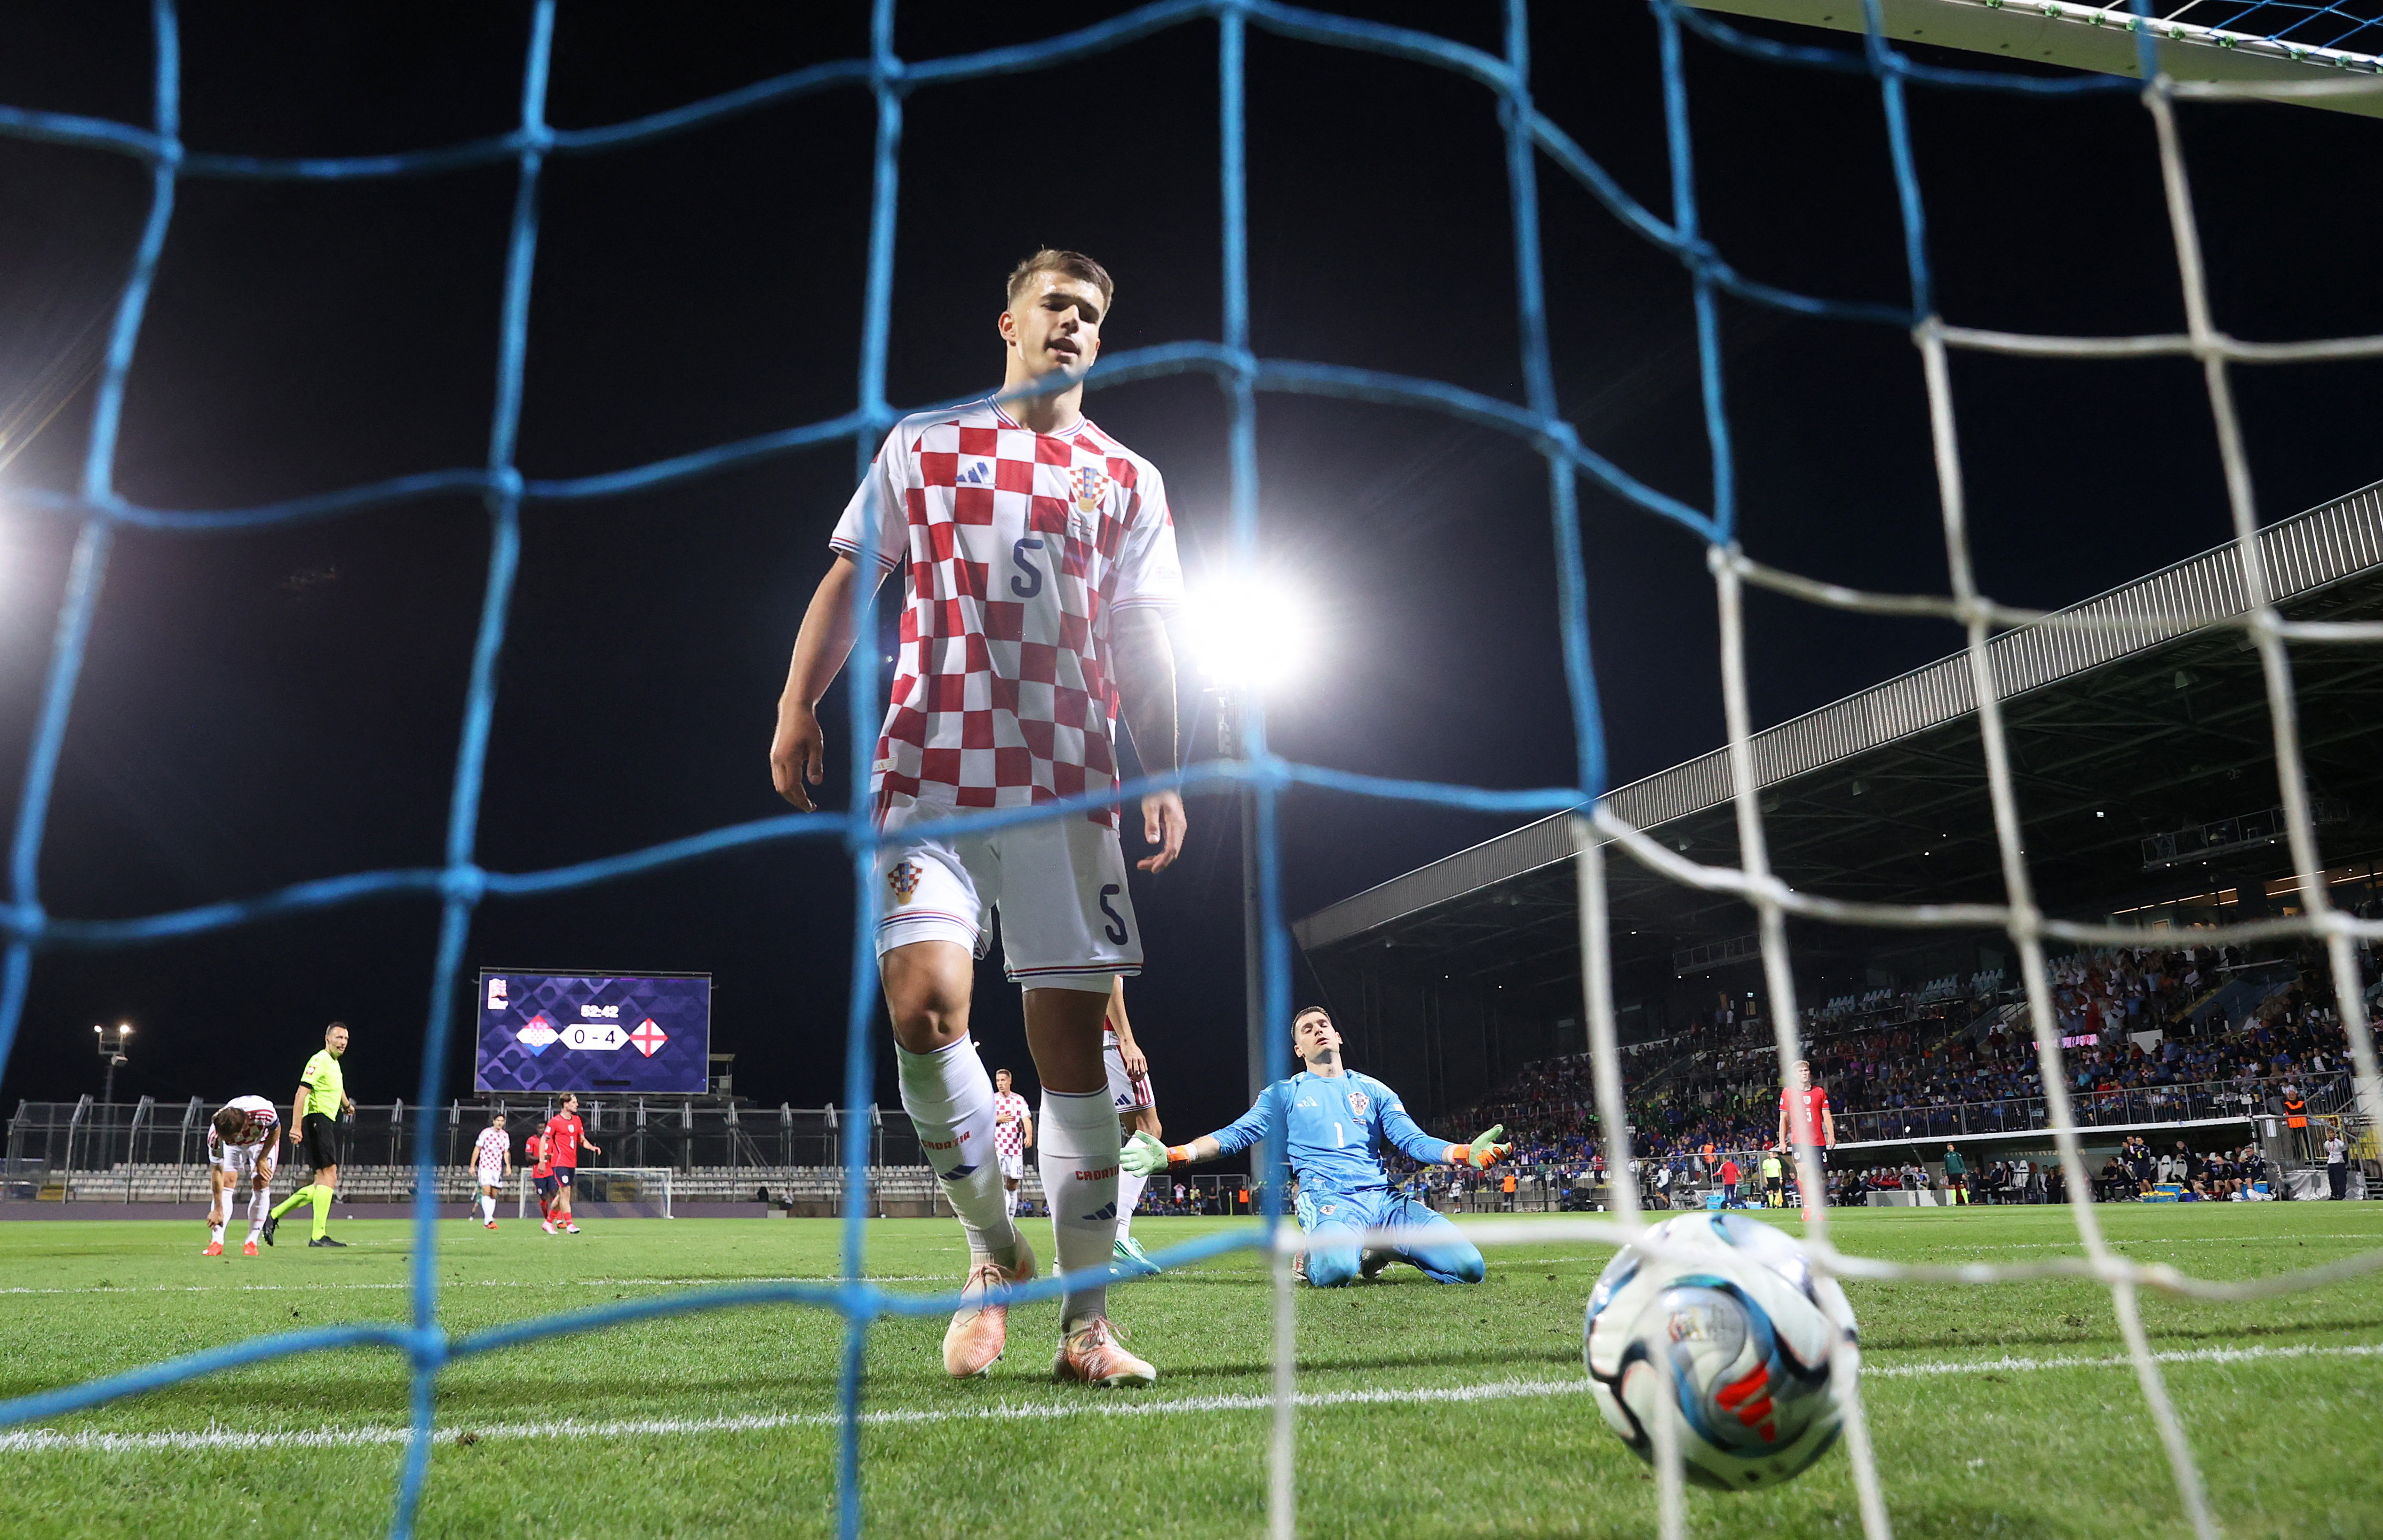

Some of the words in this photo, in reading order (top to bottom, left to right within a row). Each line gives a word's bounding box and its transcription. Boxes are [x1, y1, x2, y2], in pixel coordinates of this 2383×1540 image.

[1011, 538, 1044, 598] 5
[1100, 884, 1128, 945] 5
[581, 1005, 619, 1018] 52:42
[575, 1029, 585, 1044] 0
[605, 1030, 615, 1044] 4
[1806, 1112, 1812, 1122] 3
[921, 1130, 971, 1150] CROATIA
[1334, 1122, 1344, 1148] 1
[1822, 1152, 1828, 1163] 3
[1016, 1165, 1022, 1175] 15
[1075, 1164, 1119, 1180] CROATI
